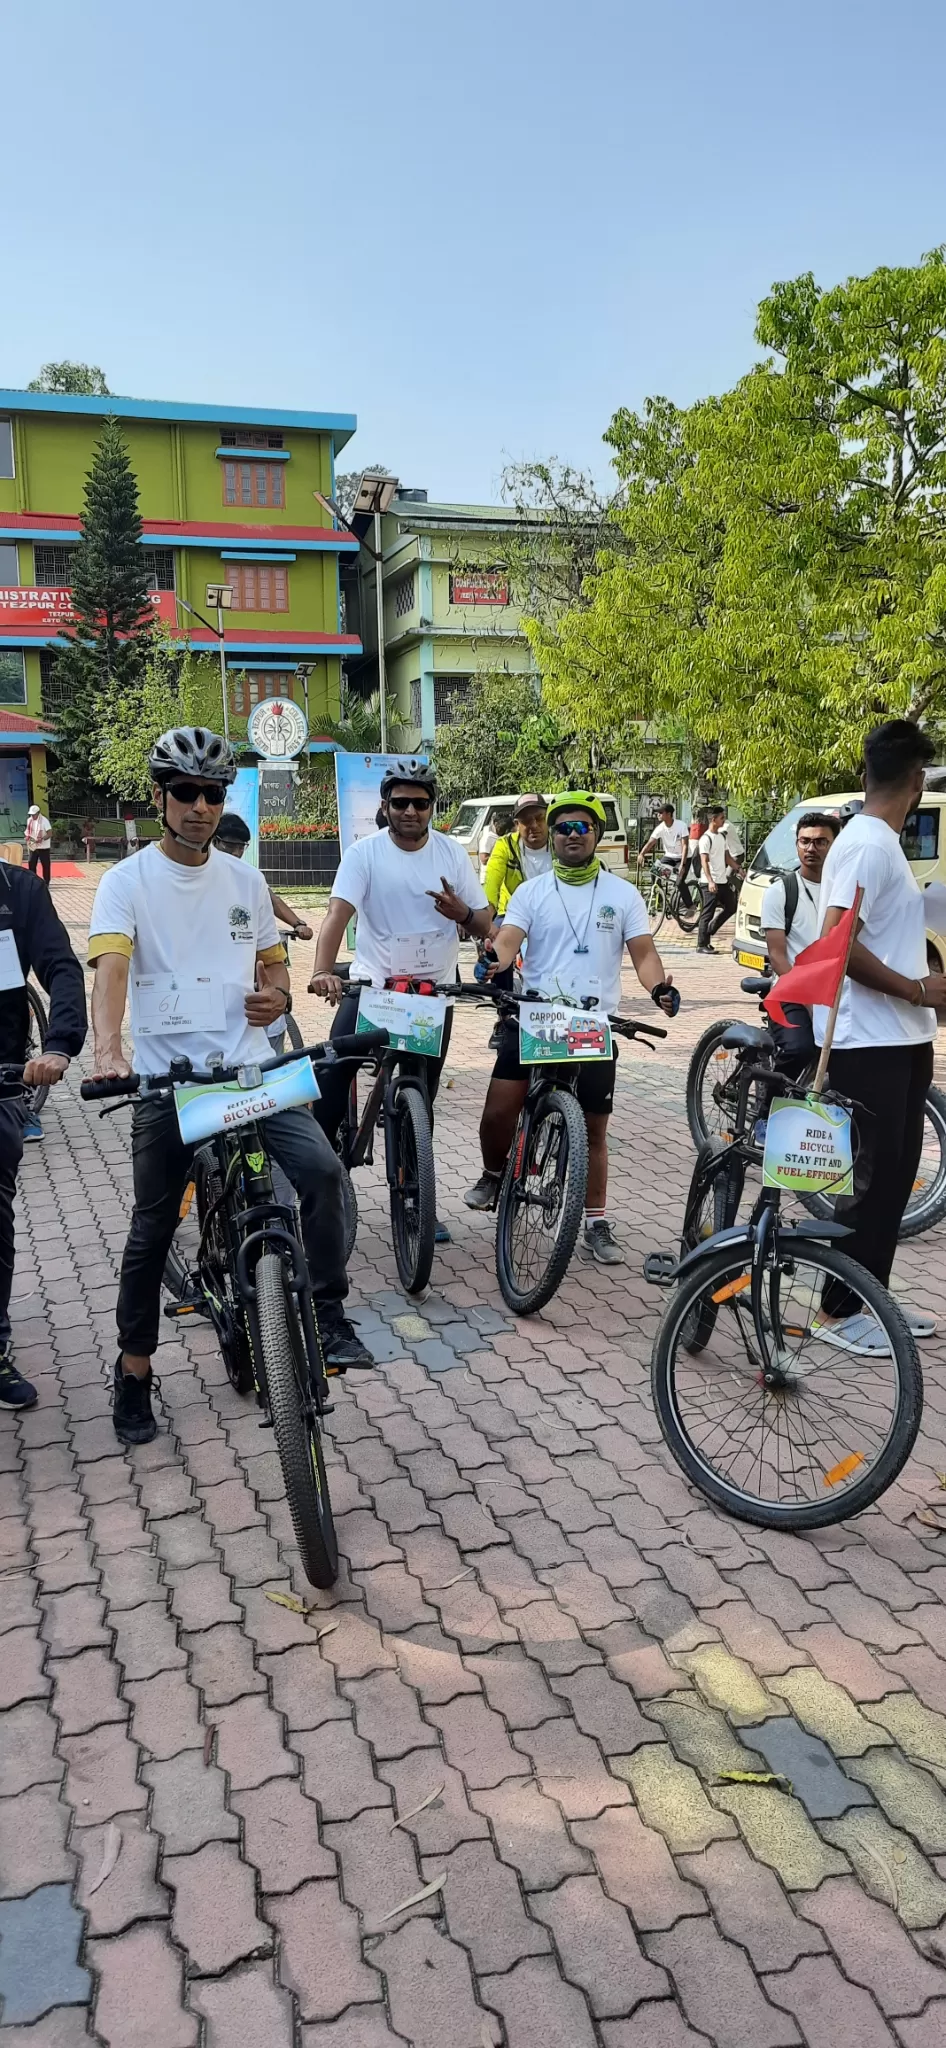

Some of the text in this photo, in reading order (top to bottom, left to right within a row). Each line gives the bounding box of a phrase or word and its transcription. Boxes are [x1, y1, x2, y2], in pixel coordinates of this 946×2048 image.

[2, 601, 55, 609] TEZPUR
[252, 707, 305, 735] TEZPUR COLLEGE
[158, 994, 180, 1012] 61
[382, 997, 395, 1005] USE
[529, 1011, 567, 1024] CARPOOL
[226, 1095, 257, 1109] RIDE
[223, 1098, 277, 1123] BICYCLE
[806, 1128, 833, 1140] RIDE A
[800, 1141, 835, 1154] BICYCLE
[784, 1153, 842, 1168] STAY FIT AND
[777, 1166, 845, 1181] FUEL-EFFICIENT
